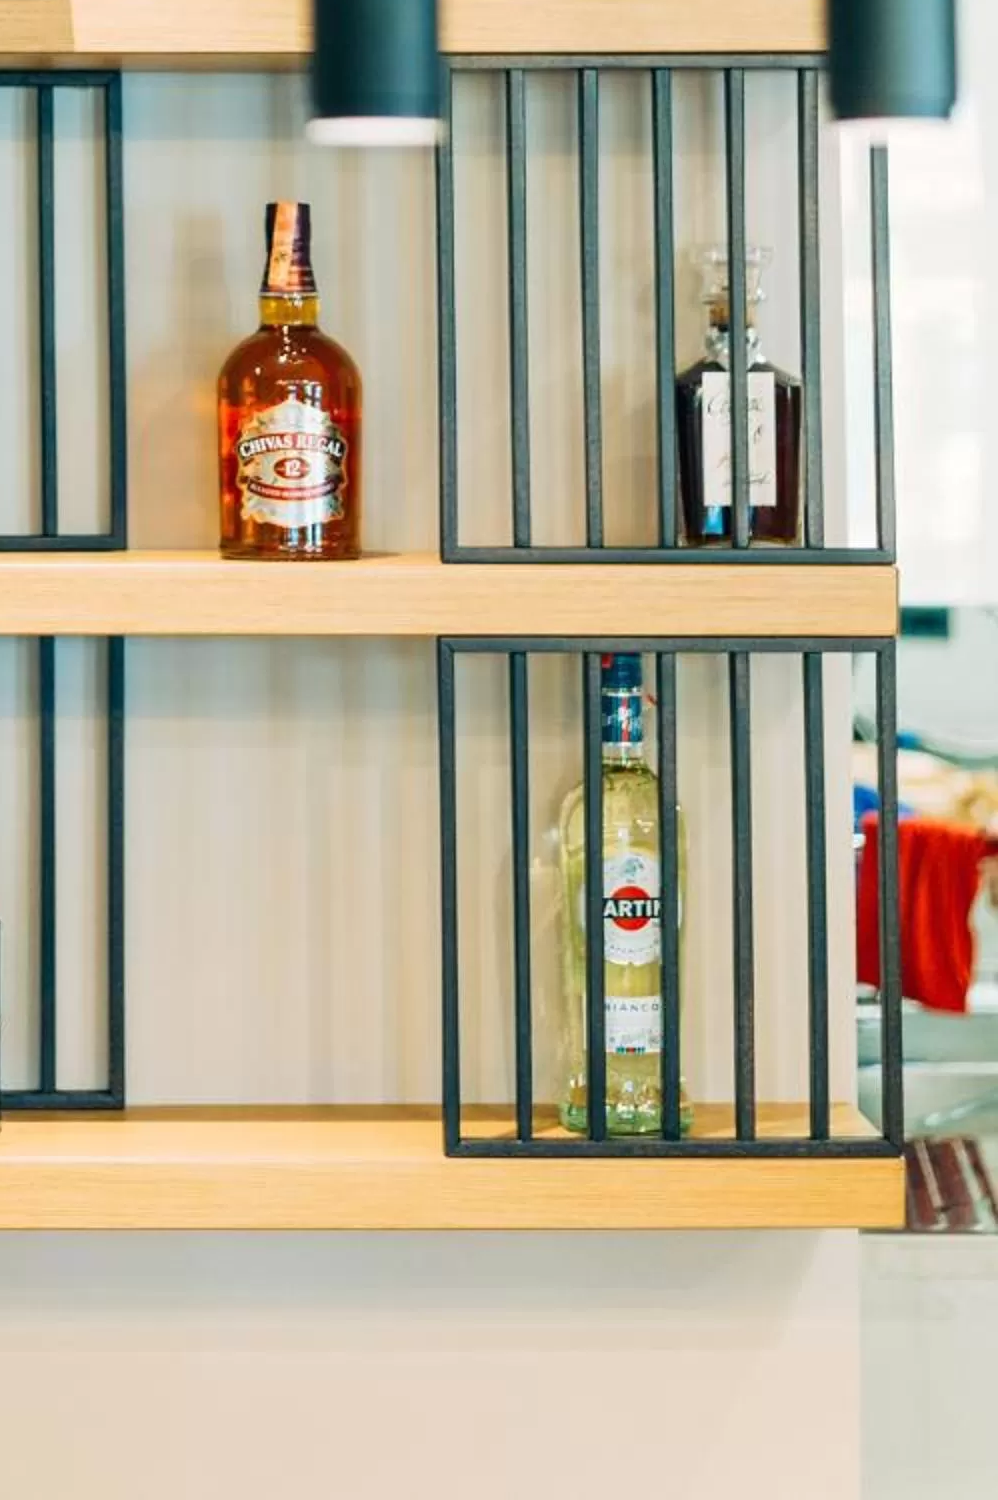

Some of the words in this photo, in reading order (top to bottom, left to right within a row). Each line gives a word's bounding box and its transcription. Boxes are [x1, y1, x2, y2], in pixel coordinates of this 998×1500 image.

[239, 435, 293, 457] CHIVAS
[296, 435, 343, 457] REGAL
[284, 460, 301, 477] 12
[603, 899, 662, 918] ARTI
